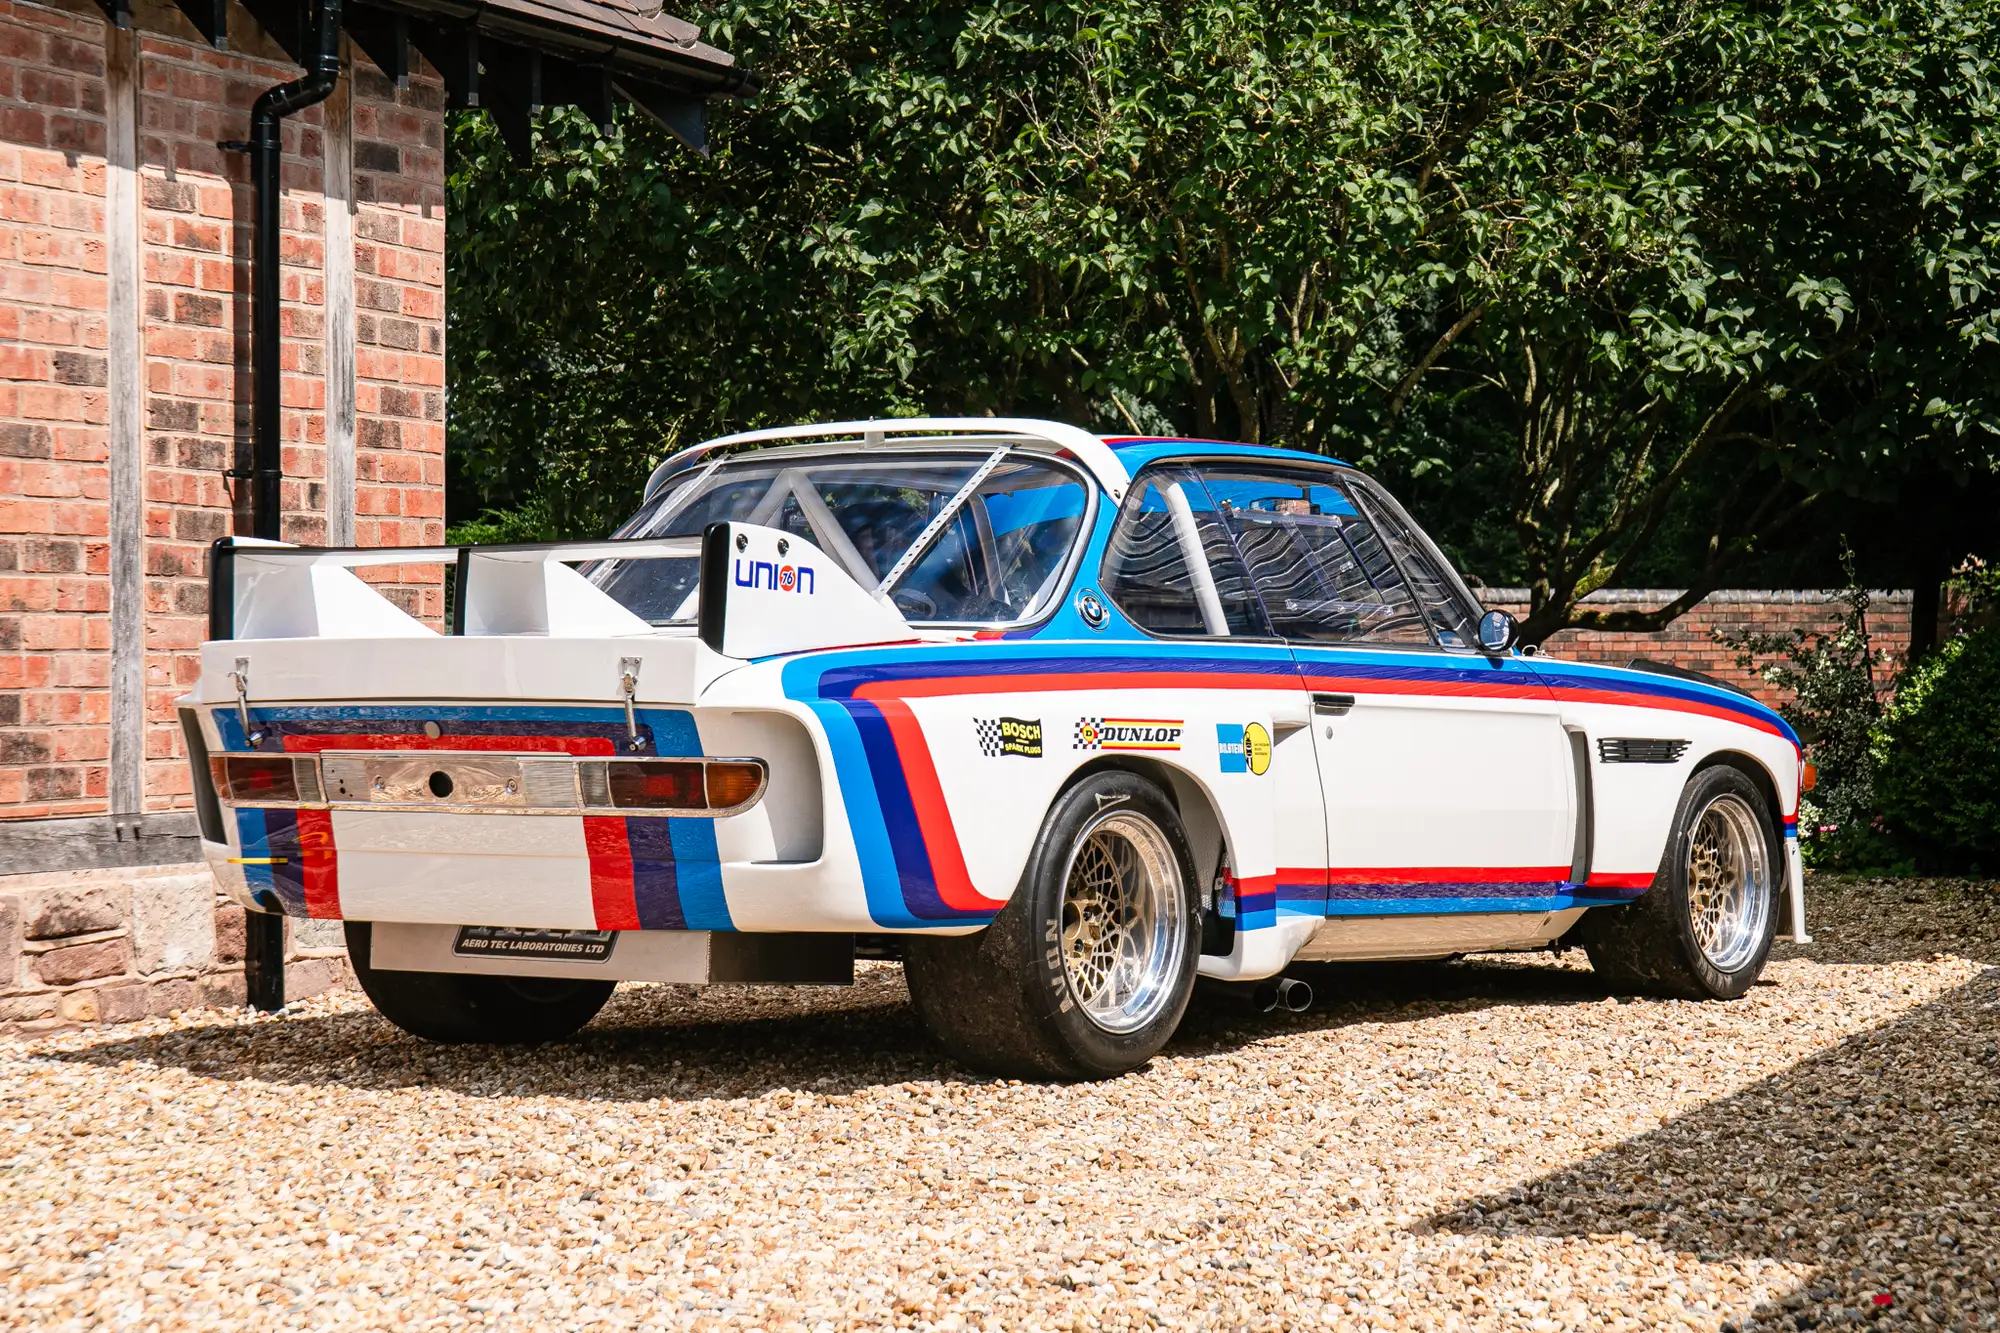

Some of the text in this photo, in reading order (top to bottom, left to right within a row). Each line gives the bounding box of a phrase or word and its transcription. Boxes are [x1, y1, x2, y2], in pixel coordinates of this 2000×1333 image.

[782, 572, 793, 585] 76
[1001, 722, 1041, 740] BOSCH
[1102, 727, 1181, 742] DUNLOP
[1004, 743, 1042, 754] SPARK PLUGS
[461, 939, 605, 953] AERO TEC LABORATORIES LTD
